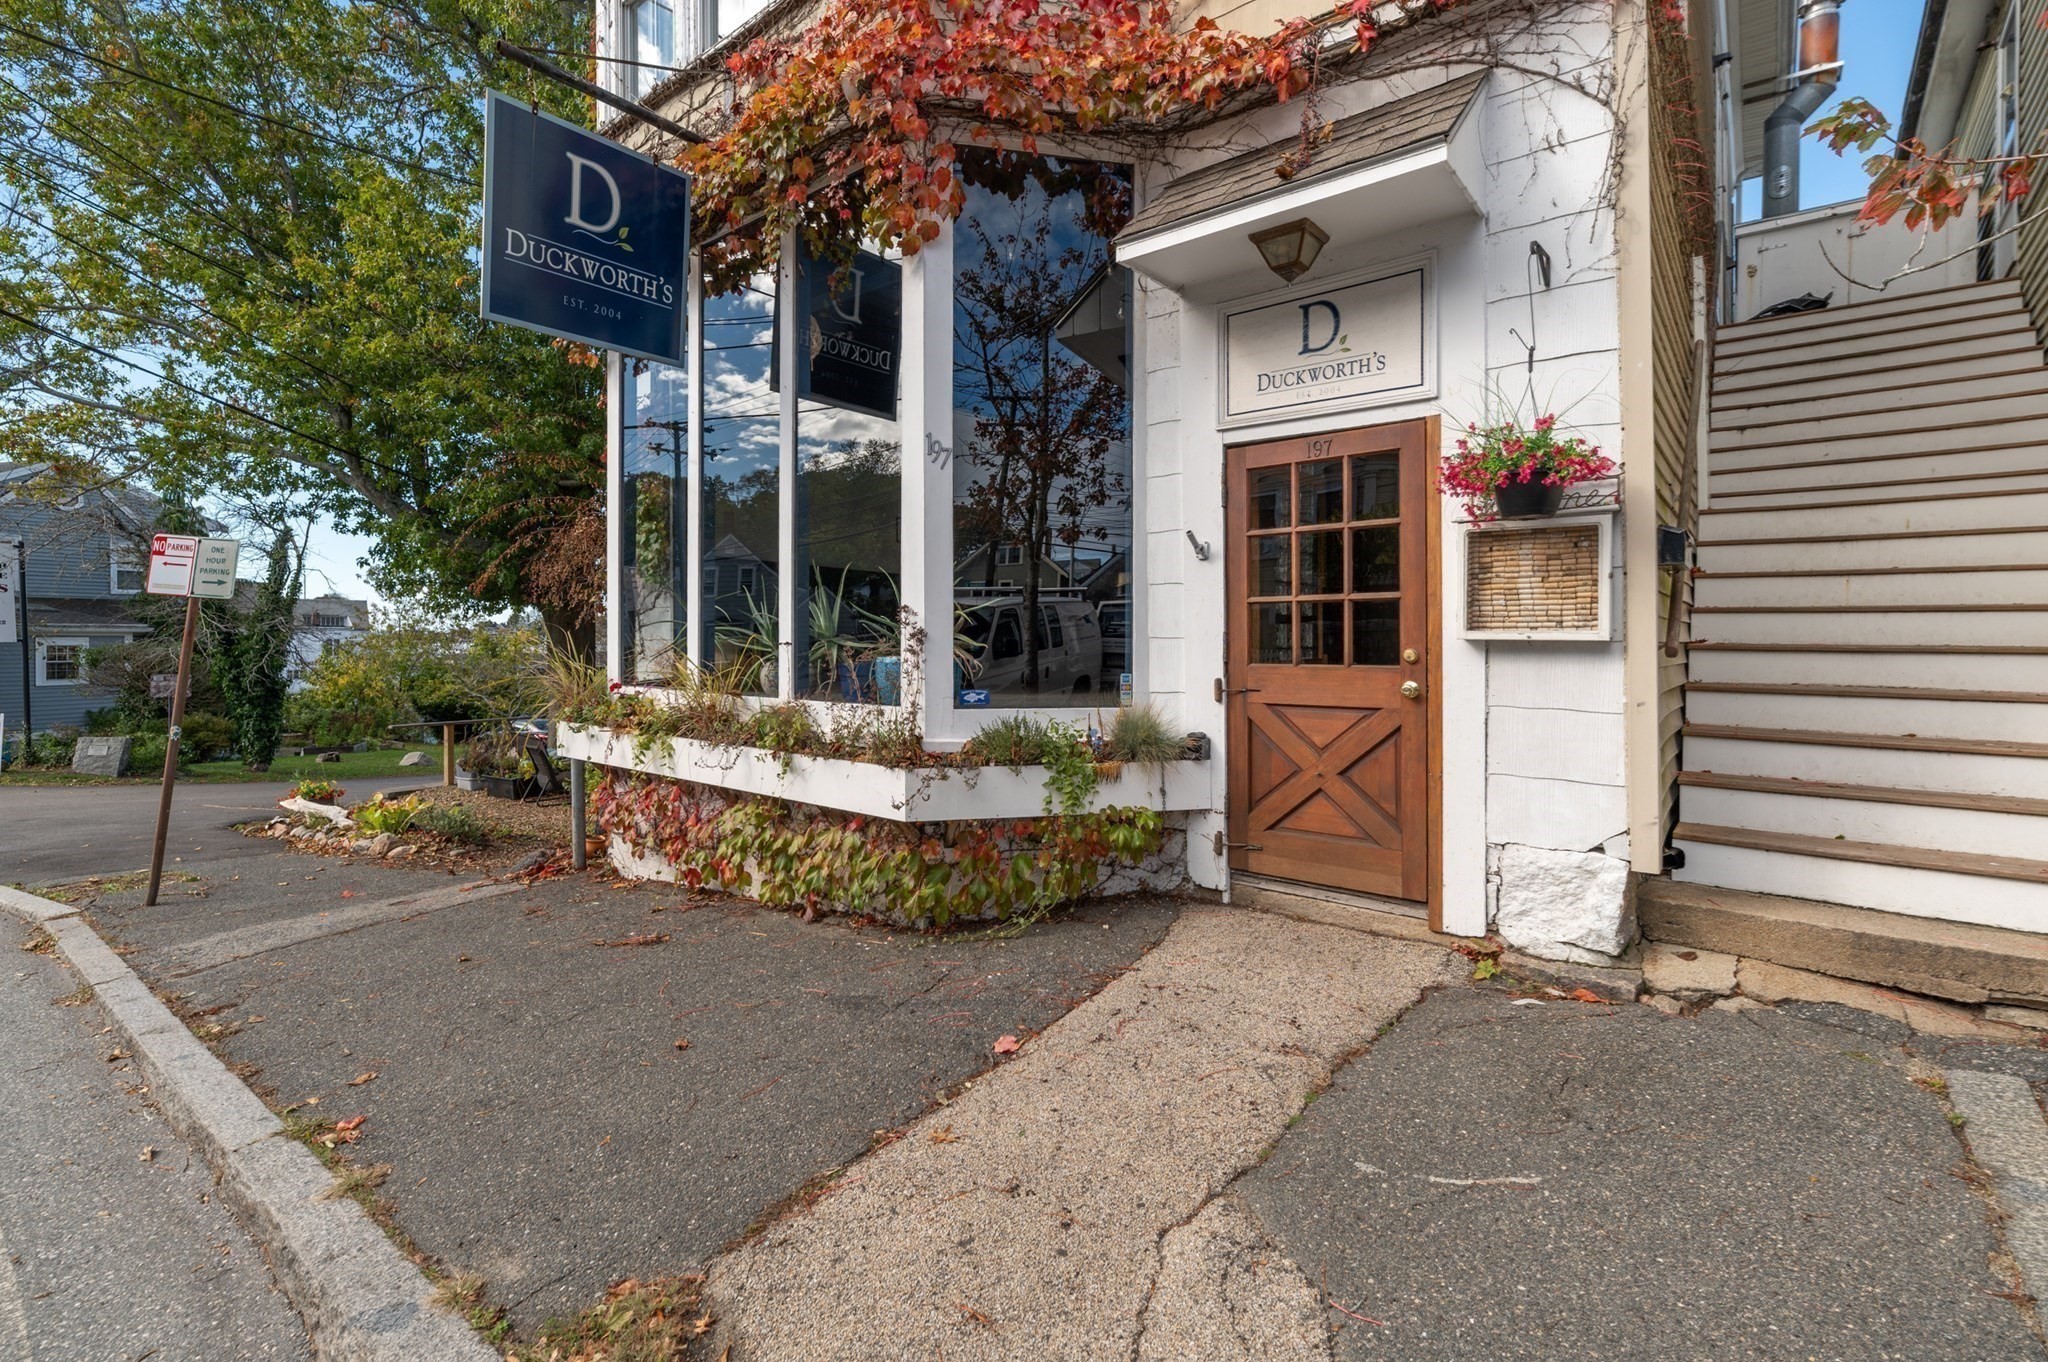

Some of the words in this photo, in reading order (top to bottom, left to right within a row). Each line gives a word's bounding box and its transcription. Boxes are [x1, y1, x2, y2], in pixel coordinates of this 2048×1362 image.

[564, 151, 621, 233] D
[505, 227, 673, 304] DUCKWORTH'S
[563, 295, 588, 311] EST.
[593, 304, 622, 320] 2004
[1298, 300, 1341, 356] D
[1256, 351, 1386, 393] DUCKWORTH'S
[1319, 385, 1341, 396] 2004
[925, 432, 952, 470] 197
[1306, 438, 1333, 459] 197
[153, 540, 166, 552] NO
[167, 543, 194, 552] PARKING
[211, 546, 225, 554] ONE
[200, 567, 230, 575] PARKING
